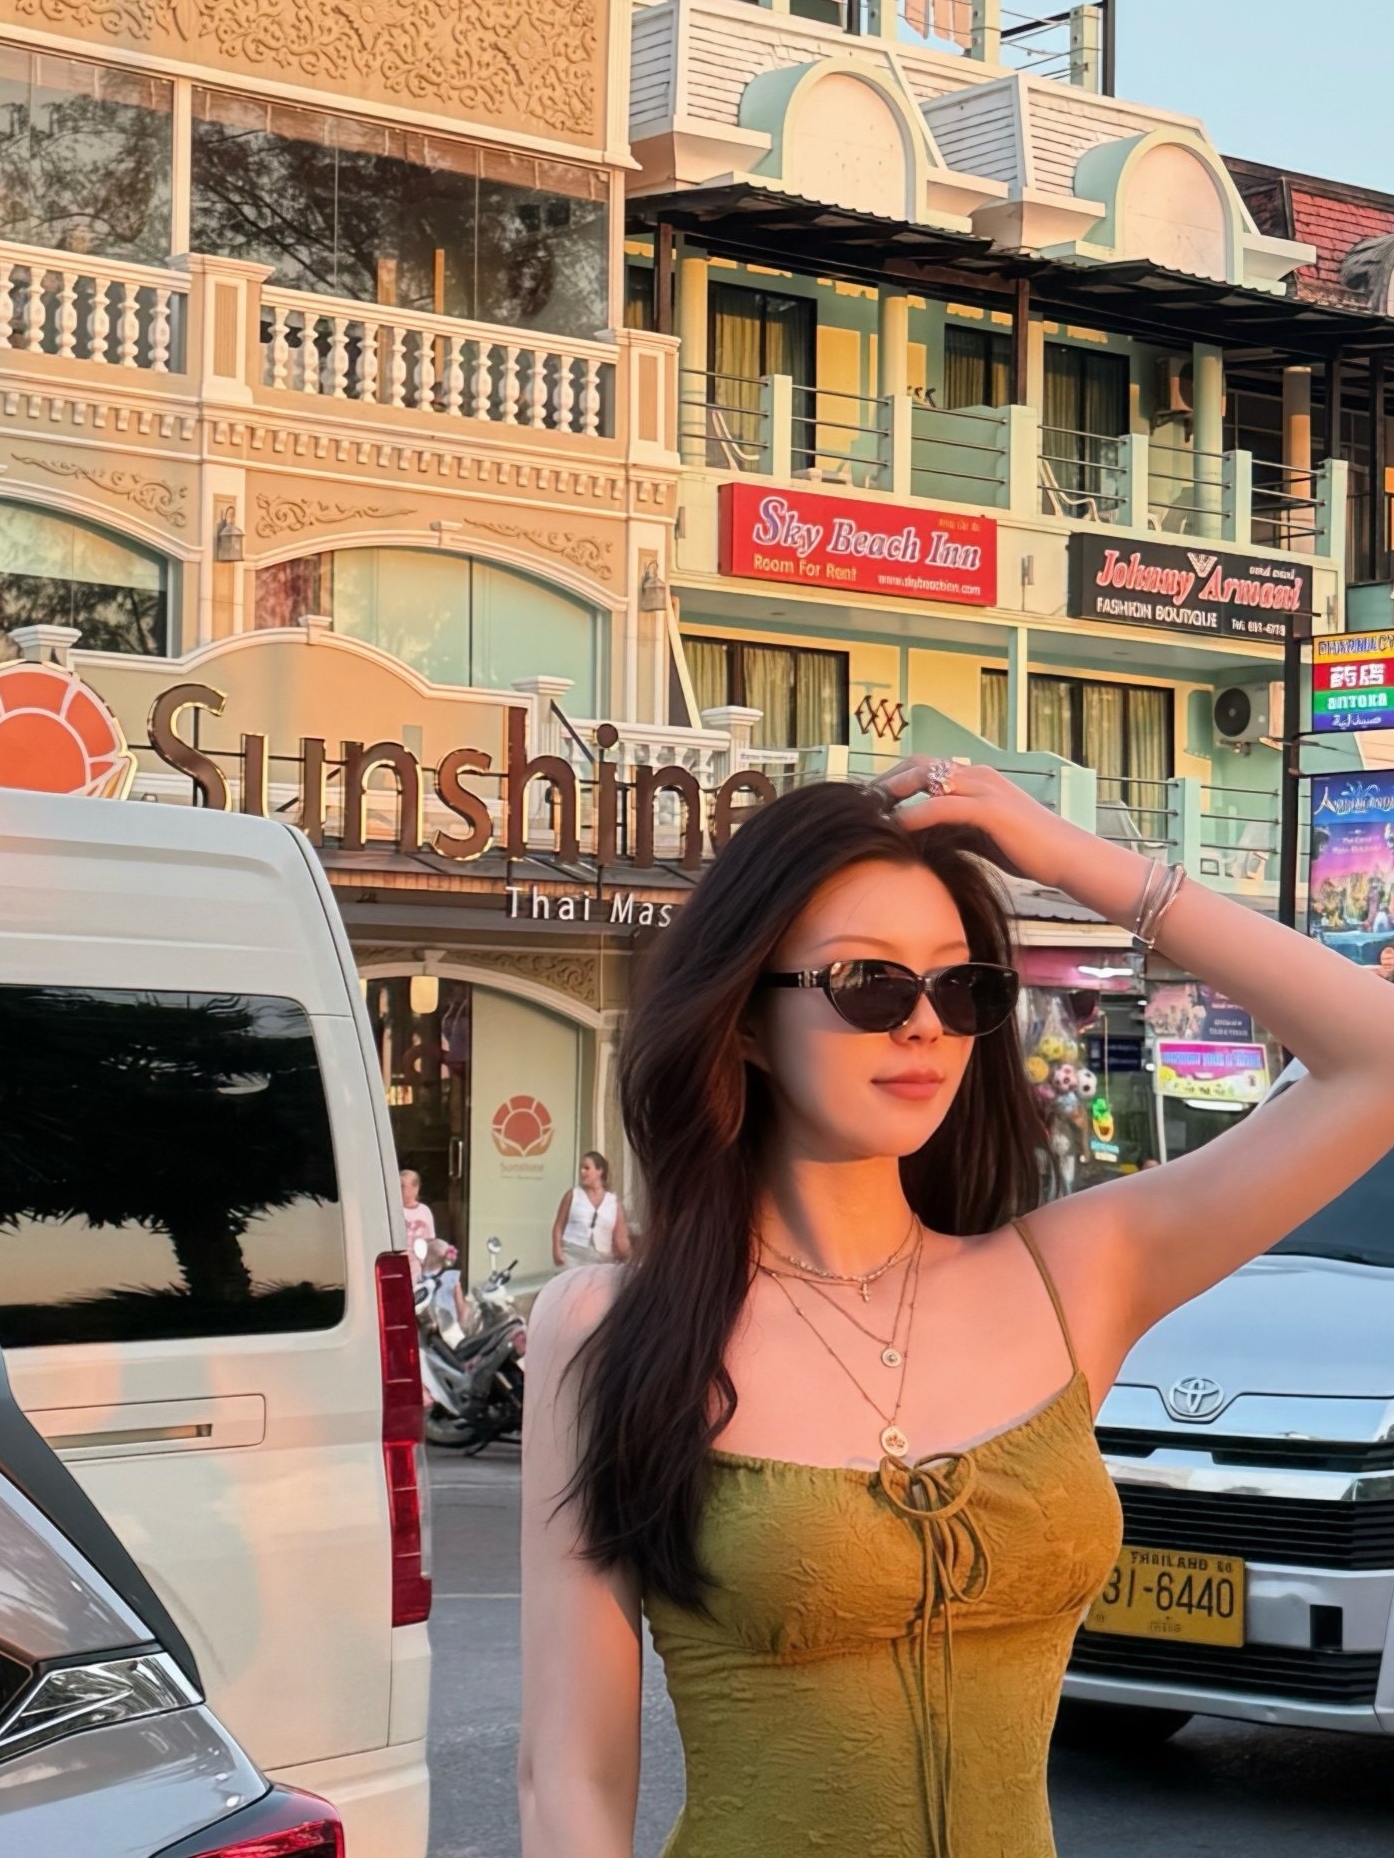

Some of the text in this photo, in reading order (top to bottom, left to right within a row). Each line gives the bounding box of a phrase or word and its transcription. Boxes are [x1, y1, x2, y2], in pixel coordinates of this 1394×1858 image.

[752, 495, 982, 571] Sky Beach Inn
[753, 552, 795, 574] Room
[799, 559, 820, 577] For
[148, 682, 777, 869] Sunshine
[505, 885, 591, 921] Thai
[1130, 1551, 1209, 1571] THAILAND
[1102, 1566, 1234, 1618] 31-6440
